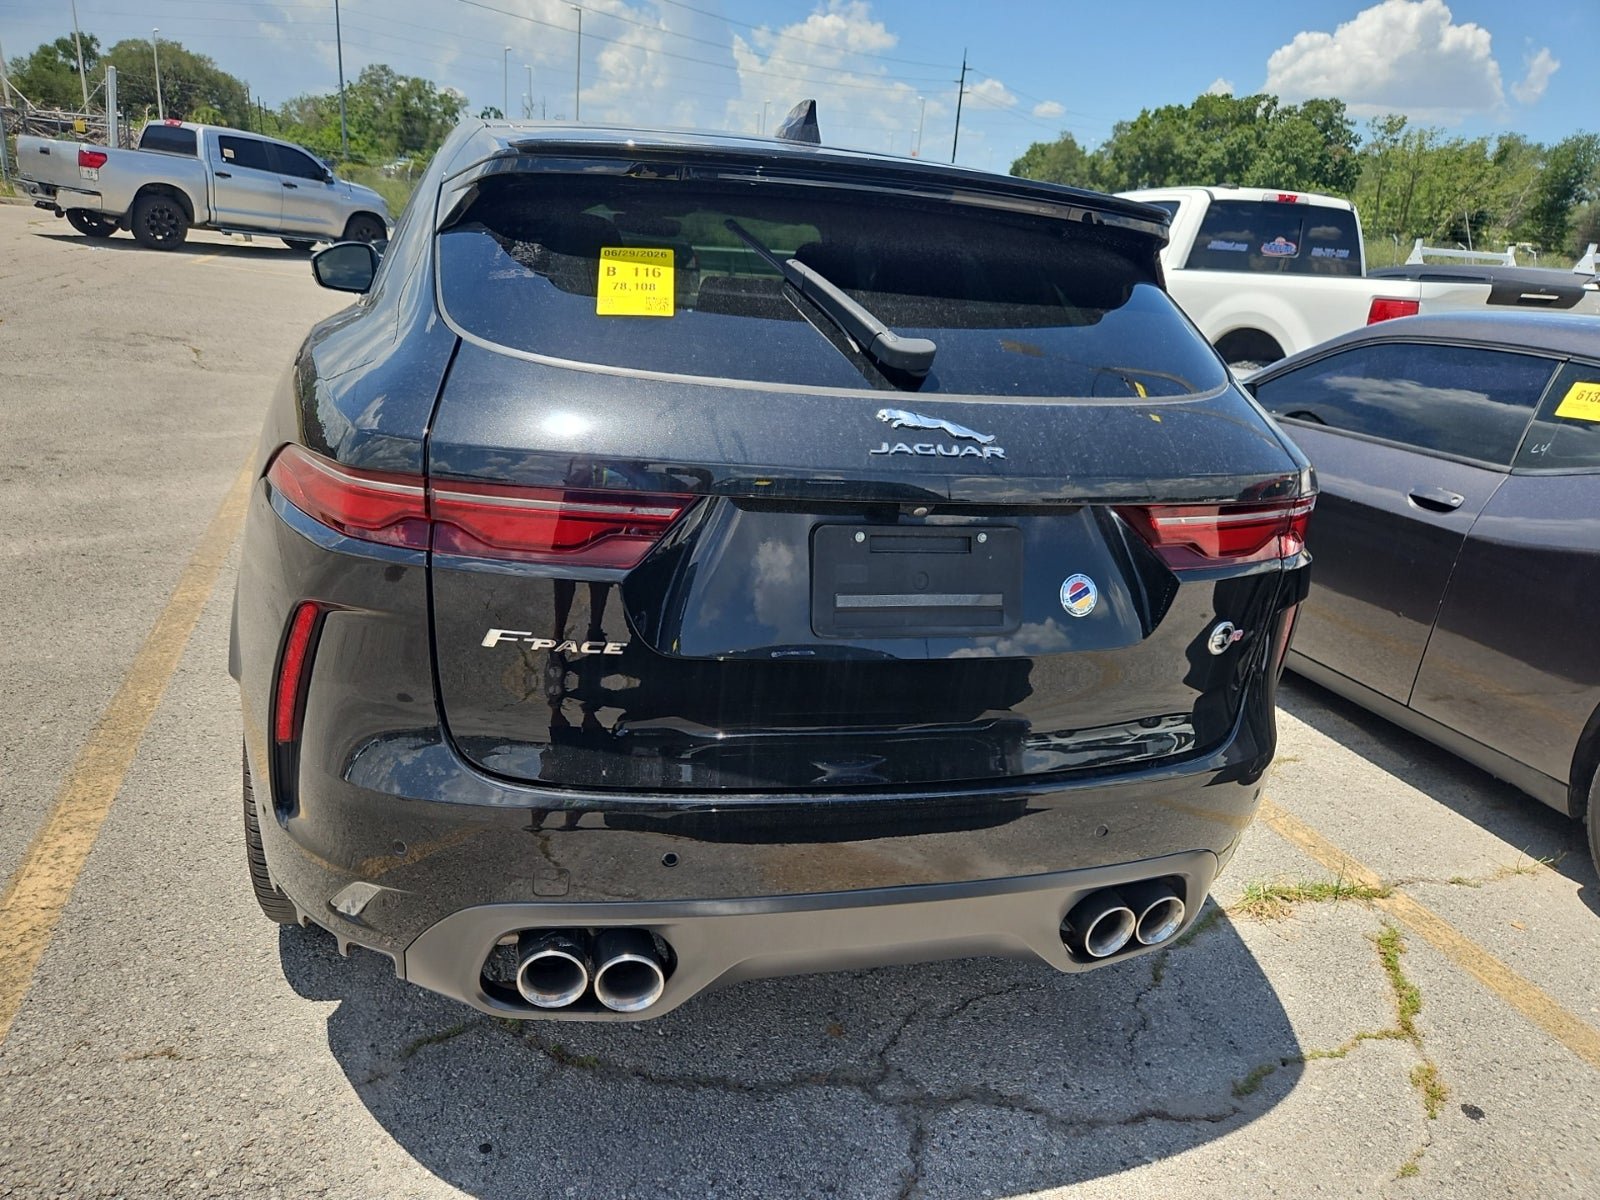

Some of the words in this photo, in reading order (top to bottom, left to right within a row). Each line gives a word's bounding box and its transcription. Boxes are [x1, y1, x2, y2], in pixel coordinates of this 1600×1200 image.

[603, 249, 668, 259] 06/29/2026
[606, 266, 617, 277] B
[633, 266, 662, 278] 116
[869, 442, 1008, 460] JAGUAR
